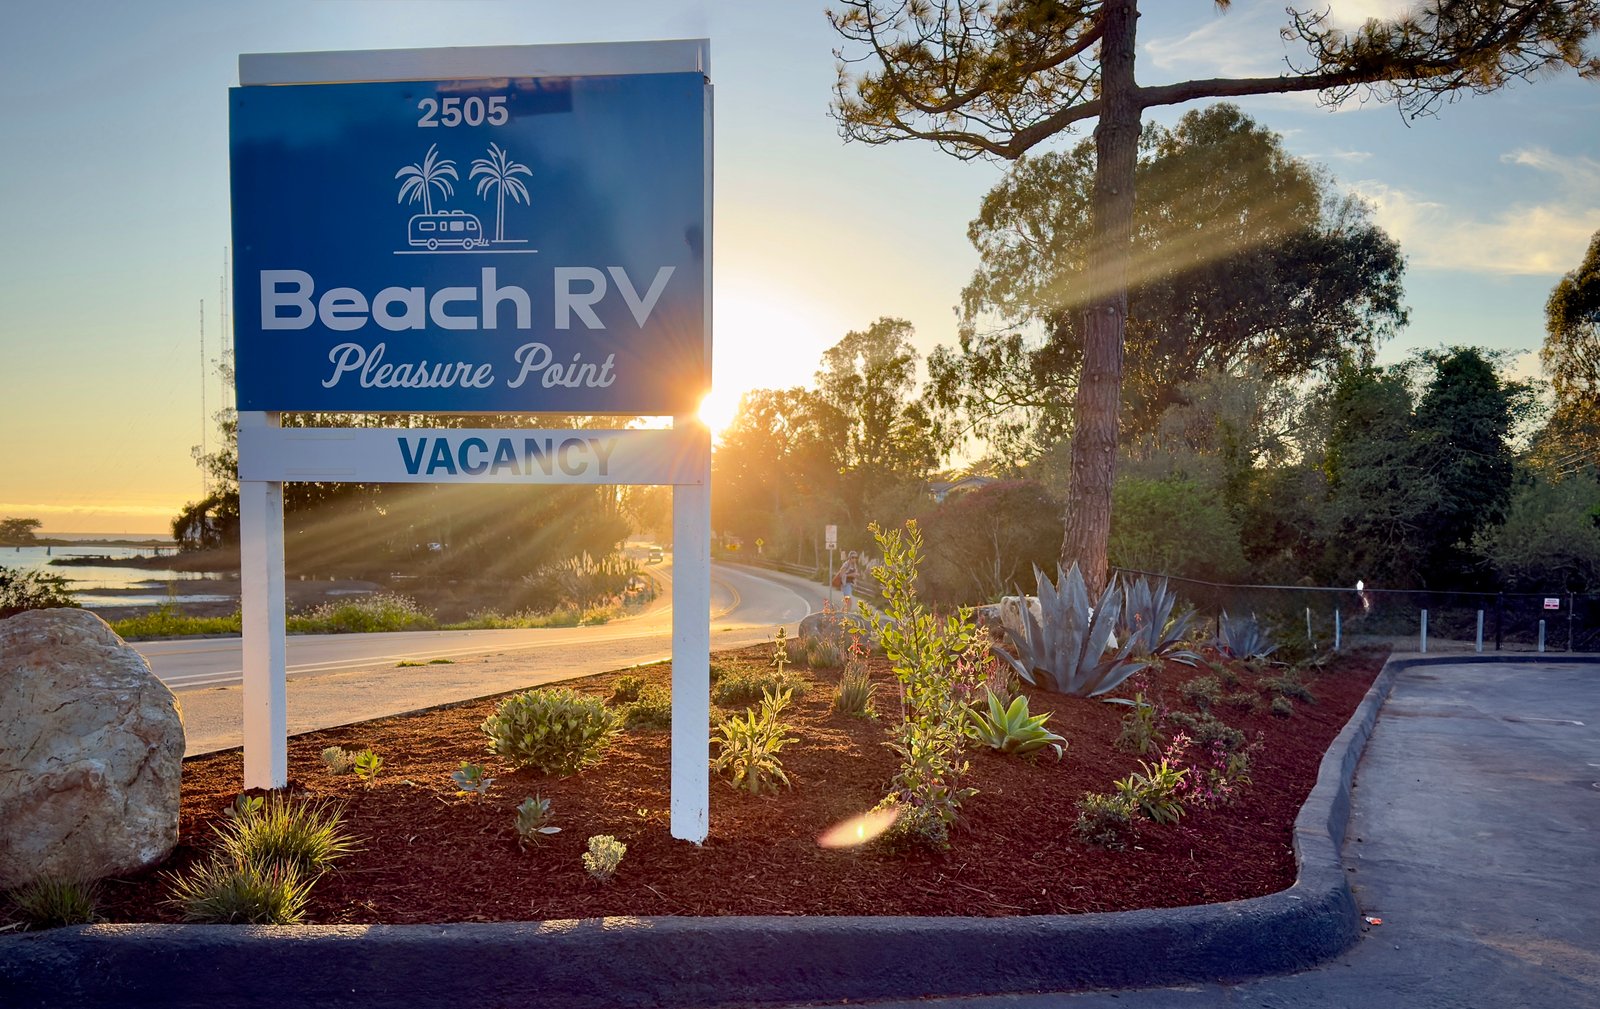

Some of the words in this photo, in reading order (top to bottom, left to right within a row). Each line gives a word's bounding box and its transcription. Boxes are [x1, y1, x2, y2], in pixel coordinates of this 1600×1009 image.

[417, 95, 509, 128] 2505
[260, 267, 531, 331] Beach
[554, 266, 676, 329] RV
[321, 342, 495, 389] Pleasure
[507, 342, 617, 389] Point
[398, 437, 613, 476] VACANCY
